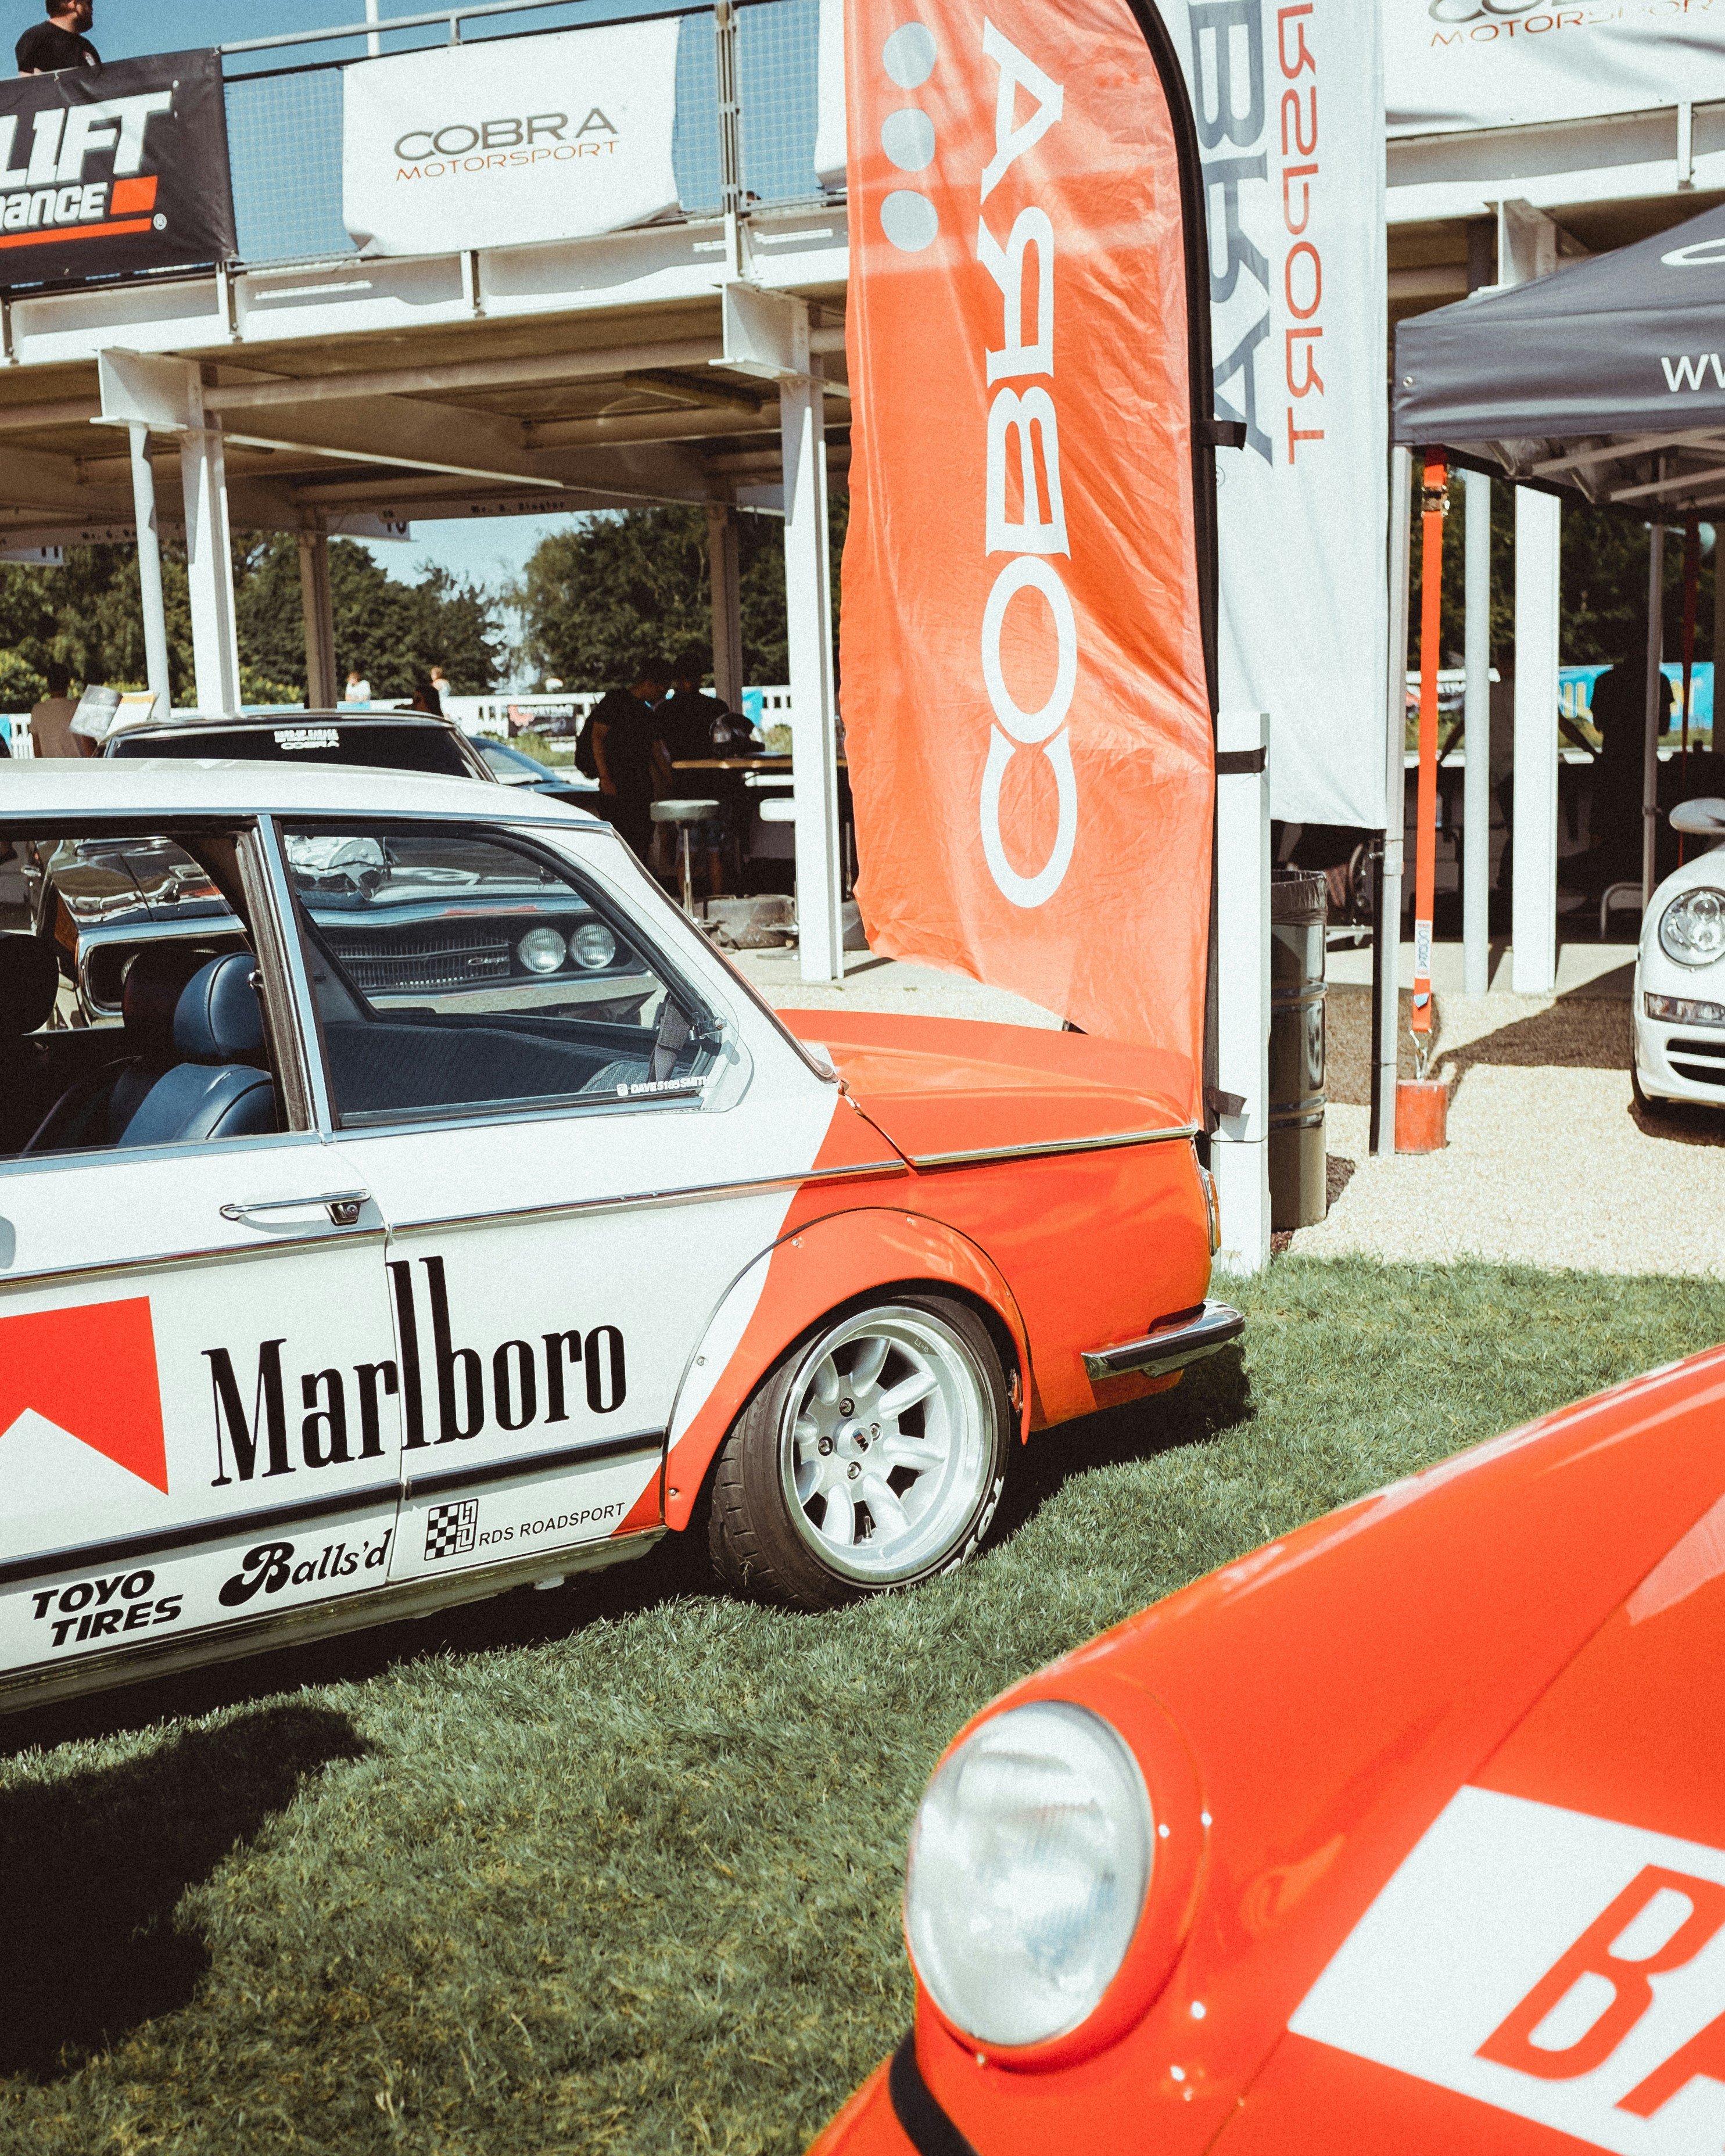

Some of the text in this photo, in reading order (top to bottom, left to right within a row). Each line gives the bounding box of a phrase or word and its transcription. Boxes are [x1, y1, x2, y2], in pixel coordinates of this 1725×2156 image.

[394, 107, 619, 161] COBRA
[396, 140, 620, 181] MOTORSPORT
[200, 1255, 627, 1487] Marlboro
[479, 1502, 626, 1547] RDS ROADSPORT
[32, 1570, 155, 1620] TOYO
[51, 1594, 183, 1648] TIRES
